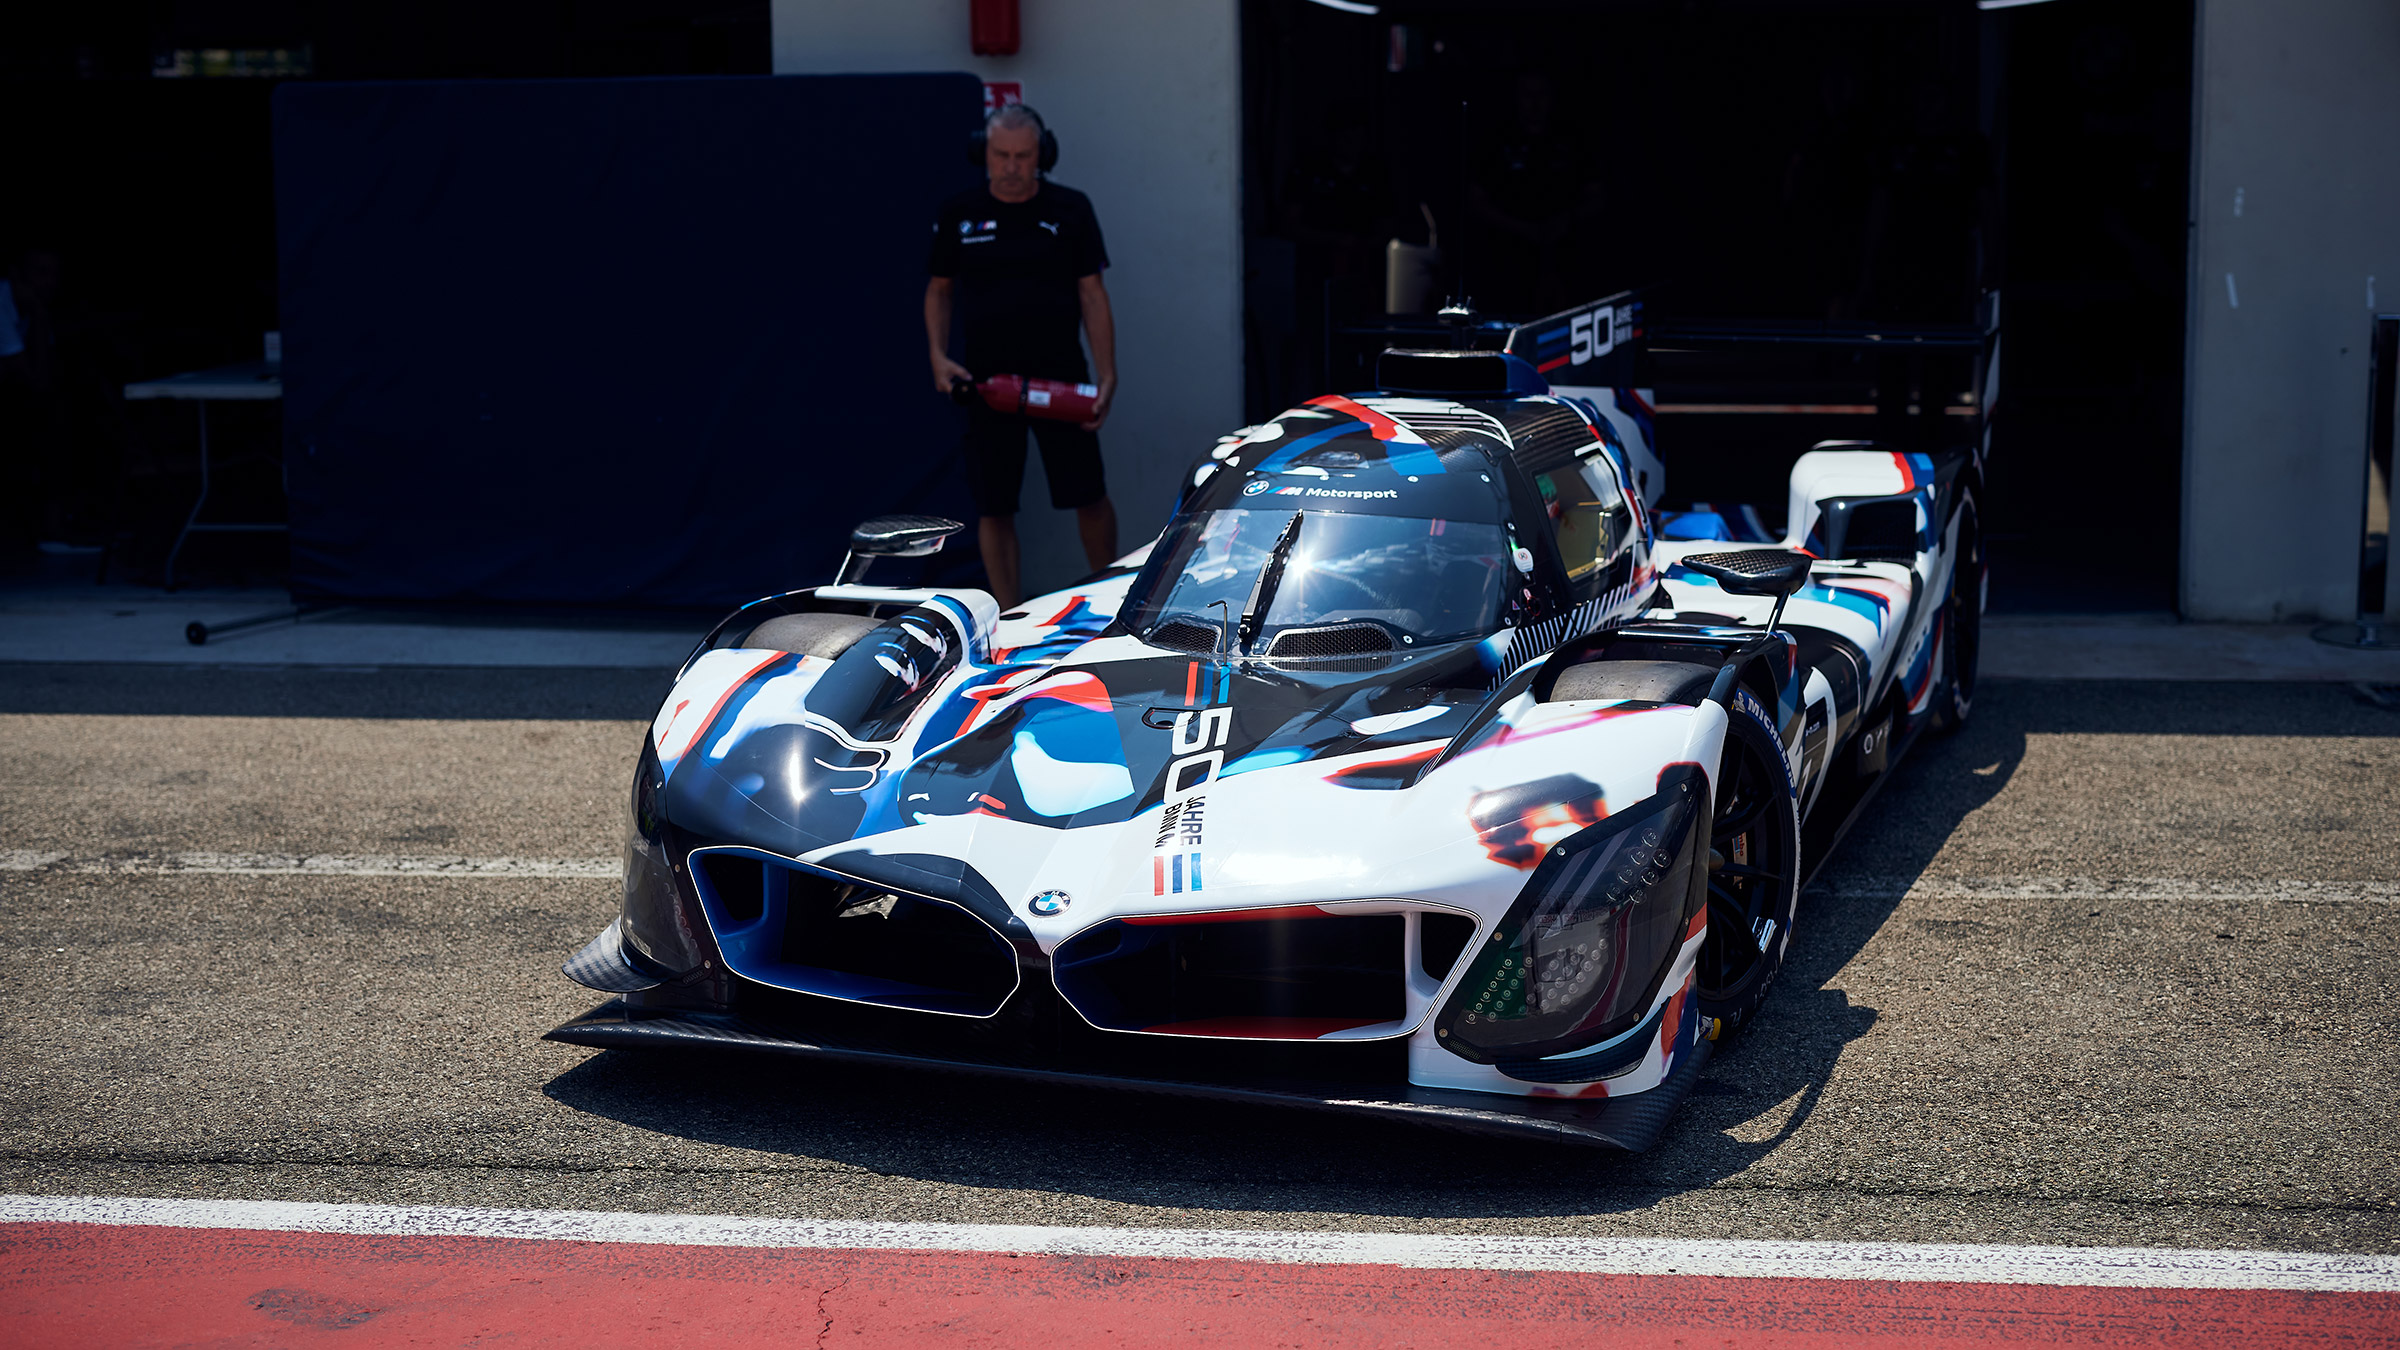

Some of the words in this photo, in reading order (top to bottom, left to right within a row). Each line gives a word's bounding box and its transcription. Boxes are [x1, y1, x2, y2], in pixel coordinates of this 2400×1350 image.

[1570, 305, 1614, 366] 50
[1305, 488, 1398, 500] Motorsport
[1163, 706, 1234, 804] 50
[1747, 697, 1795, 789] MICHELIN
[1158, 802, 1184, 834] BMW
[1179, 796, 1206, 847] JAHRE
